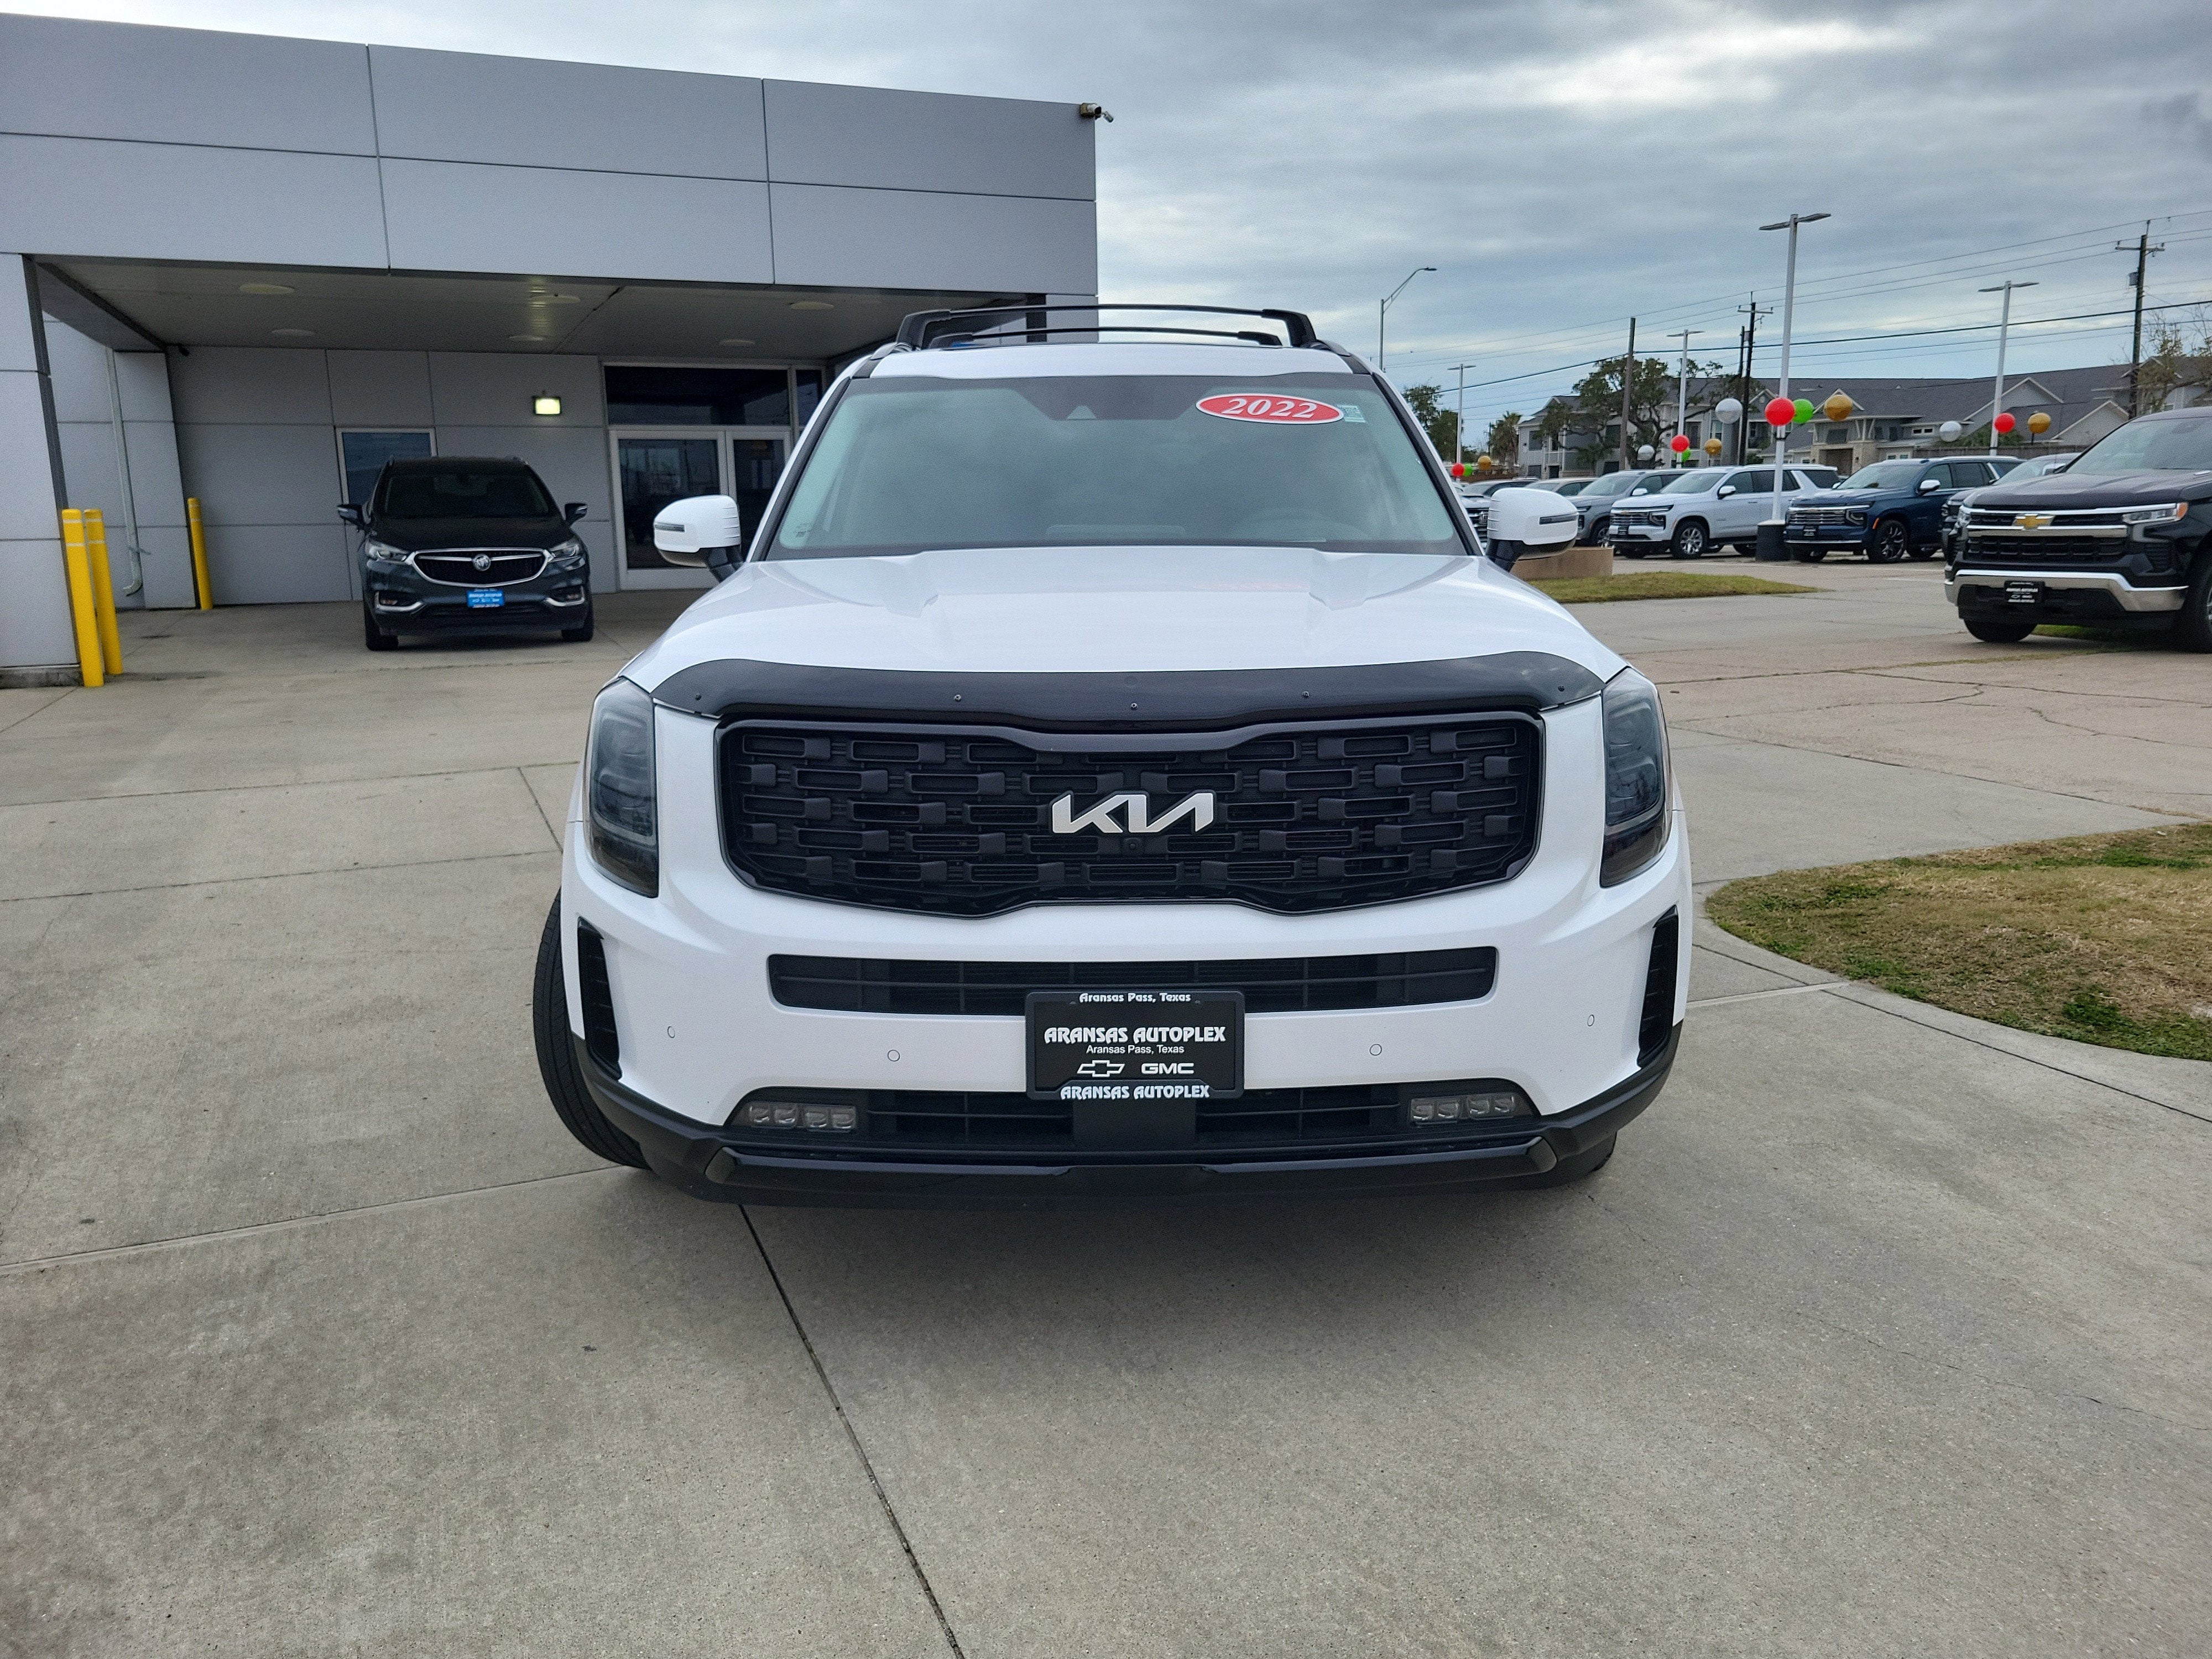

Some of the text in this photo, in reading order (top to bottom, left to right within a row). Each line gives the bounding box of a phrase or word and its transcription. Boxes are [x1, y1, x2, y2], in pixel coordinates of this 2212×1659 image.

[1221, 398, 1317, 418] 2022
[1052, 793, 1213, 833] KIA
[1079, 993, 1191, 1003] Aransas Pass, Texas
[1044, 1026, 1227, 1044] ARANSAS AUTOPLEX
[1086, 1045, 1185, 1055] Aransas Pass, Texas
[1141, 1062, 1194, 1074] GMC
[1060, 1084, 1210, 1100] ARANSAS AUTOPLEX
